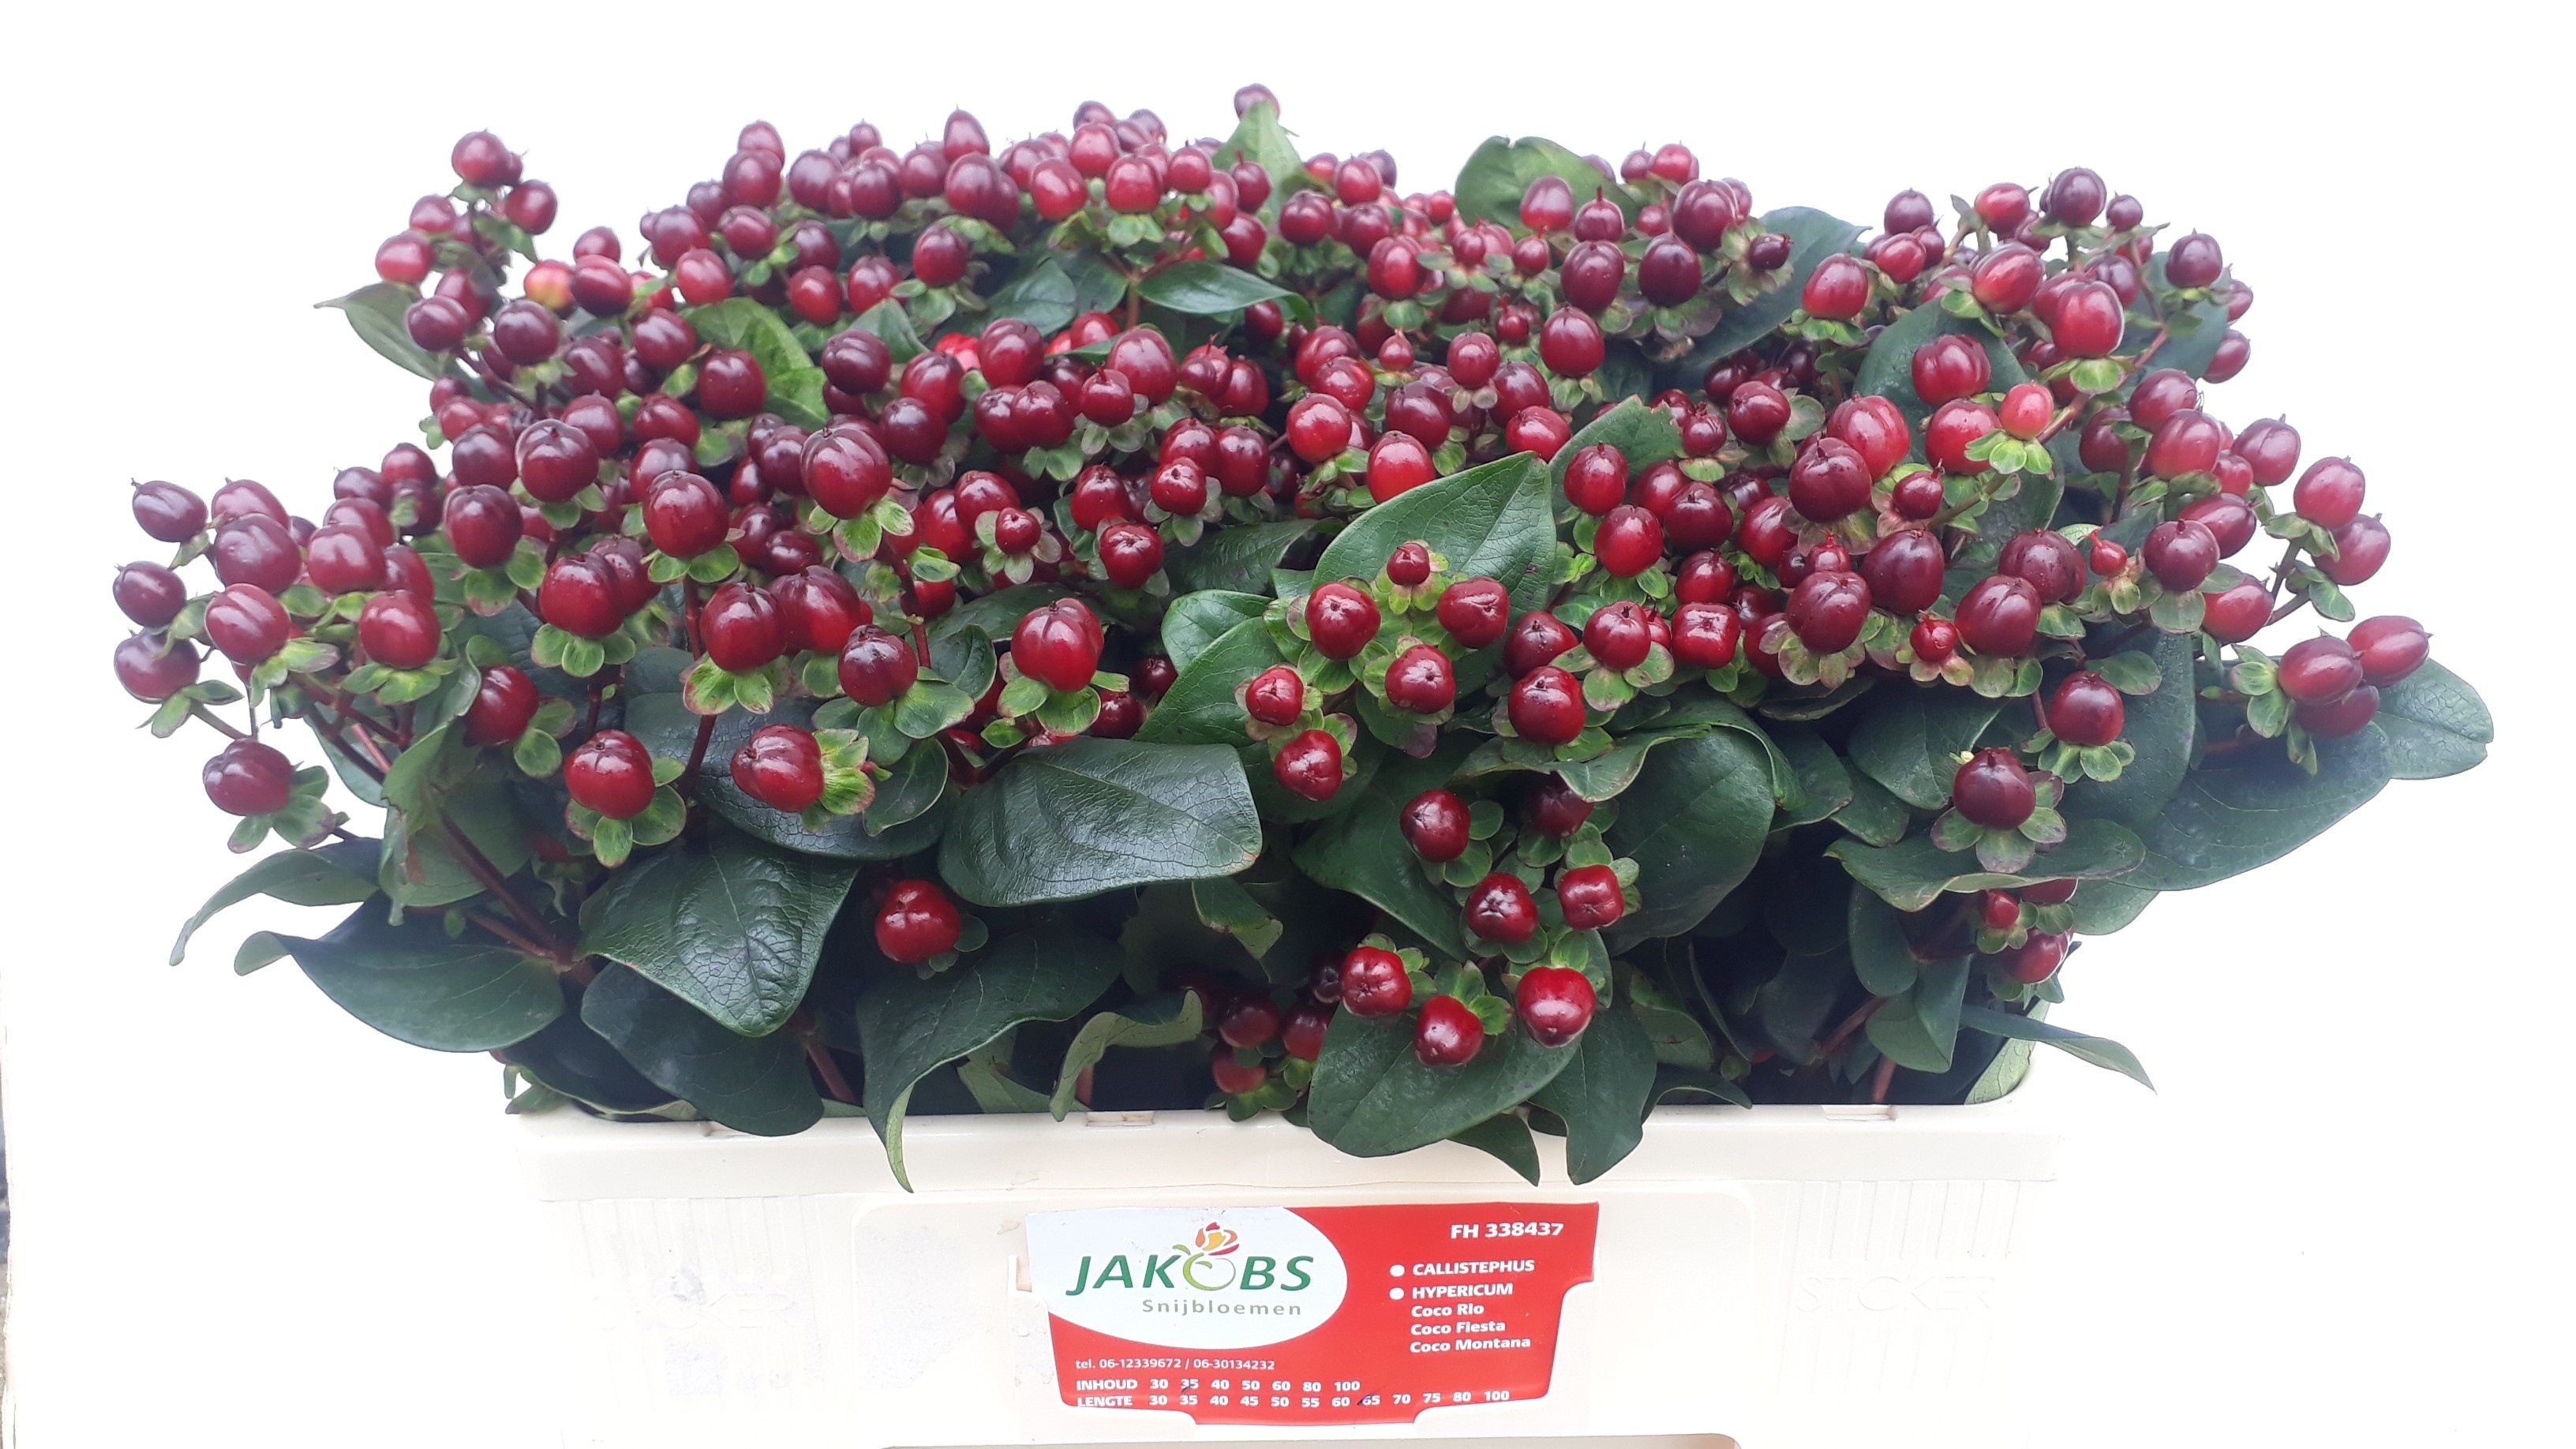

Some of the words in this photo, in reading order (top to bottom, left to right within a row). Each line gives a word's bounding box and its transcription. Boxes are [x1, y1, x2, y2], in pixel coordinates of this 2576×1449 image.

[1451, 1224, 1479, 1239] FH
[1485, 1222, 1564, 1238] 338437
[1065, 1253, 1314, 1297] JAKOBS
[1412, 1259, 1535, 1276] CALLISTEPHUS
[1412, 1282, 1514, 1300] HYPERICUM
[1141, 1299, 1301, 1316] Snijbloemen
[1411, 1305, 1453, 1318] Coco
[1457, 1302, 1485, 1316] Rio
[1410, 1324, 1452, 1336] Coco
[1456, 1320, 1506, 1334] Fiesta
[1410, 1341, 1451, 1354] Coco
[1455, 1338, 1531, 1351] Montana
[1075, 1358, 1096, 1369] tel.
[1099, 1357, 1181, 1369] 06-12339672
[1185, 1358, 1190, 1371] /
[1193, 1358, 1275, 1371] 06-30134232
[1076, 1379, 1139, 1391] INHOUD
[1150, 1378, 1169, 1390] 30
[1181, 1379, 1199, 1390] 35
[1211, 1379, 1230, 1391] 40
[1241, 1380, 1260, 1391] 50
[1271, 1380, 1291, 1391] 60
[1302, 1381, 1322, 1393] 80
[1334, 1380, 1361, 1392] 100
[1077, 1395, 1133, 1407] LENGTE
[1148, 1395, 1169, 1406] 30
[1179, 1395, 1199, 1406] 35
[1209, 1395, 1229, 1406] 40
[1240, 1395, 1259, 1406] 45
[1271, 1396, 1290, 1407] 50
[1301, 1397, 1320, 1409] 55
[1331, 1396, 1350, 1408] 60
[1362, 1395, 1381, 1406] 65
[1392, 1394, 1411, 1405] 70
[1423, 1392, 1441, 1404] 75
[1452, 1391, 1472, 1403] 80
[1484, 1390, 1511, 1401] 100
